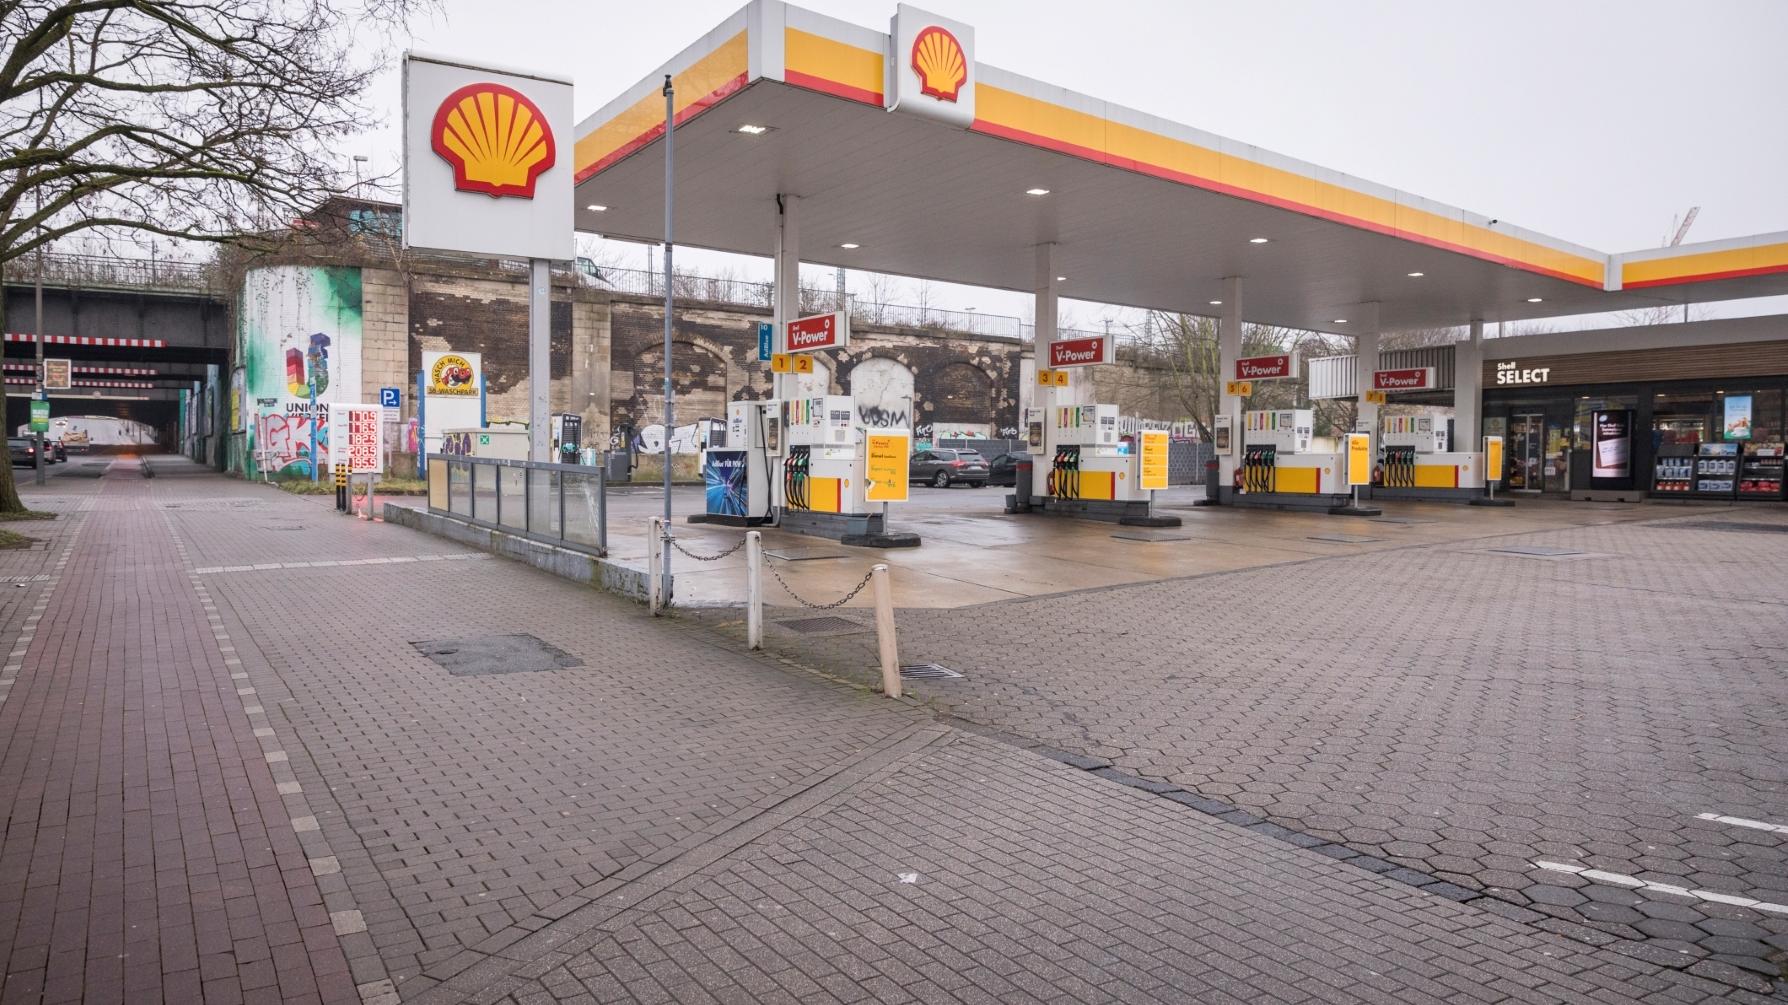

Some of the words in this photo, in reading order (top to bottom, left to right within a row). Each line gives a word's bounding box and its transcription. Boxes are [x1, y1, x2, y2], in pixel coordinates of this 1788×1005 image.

[792, 331, 828, 345] V-Power
[1056, 351, 1096, 362] V-Power
[779, 358, 784, 368] 1
[799, 360, 807, 370] 2
[1497, 361, 1516, 370] Shell
[434, 360, 446, 384] WASCH
[447, 357, 465, 367] MICH
[1242, 366, 1281, 377] V-Power
[1042, 373, 1049, 383] 3
[1057, 375, 1064, 384] 4
[1496, 368, 1550, 385] SELECT
[1379, 377, 1419, 387] V-Power
[1241, 385, 1248, 393] 6
[383, 390, 395, 405] P
[286, 403, 328, 413] UNION
